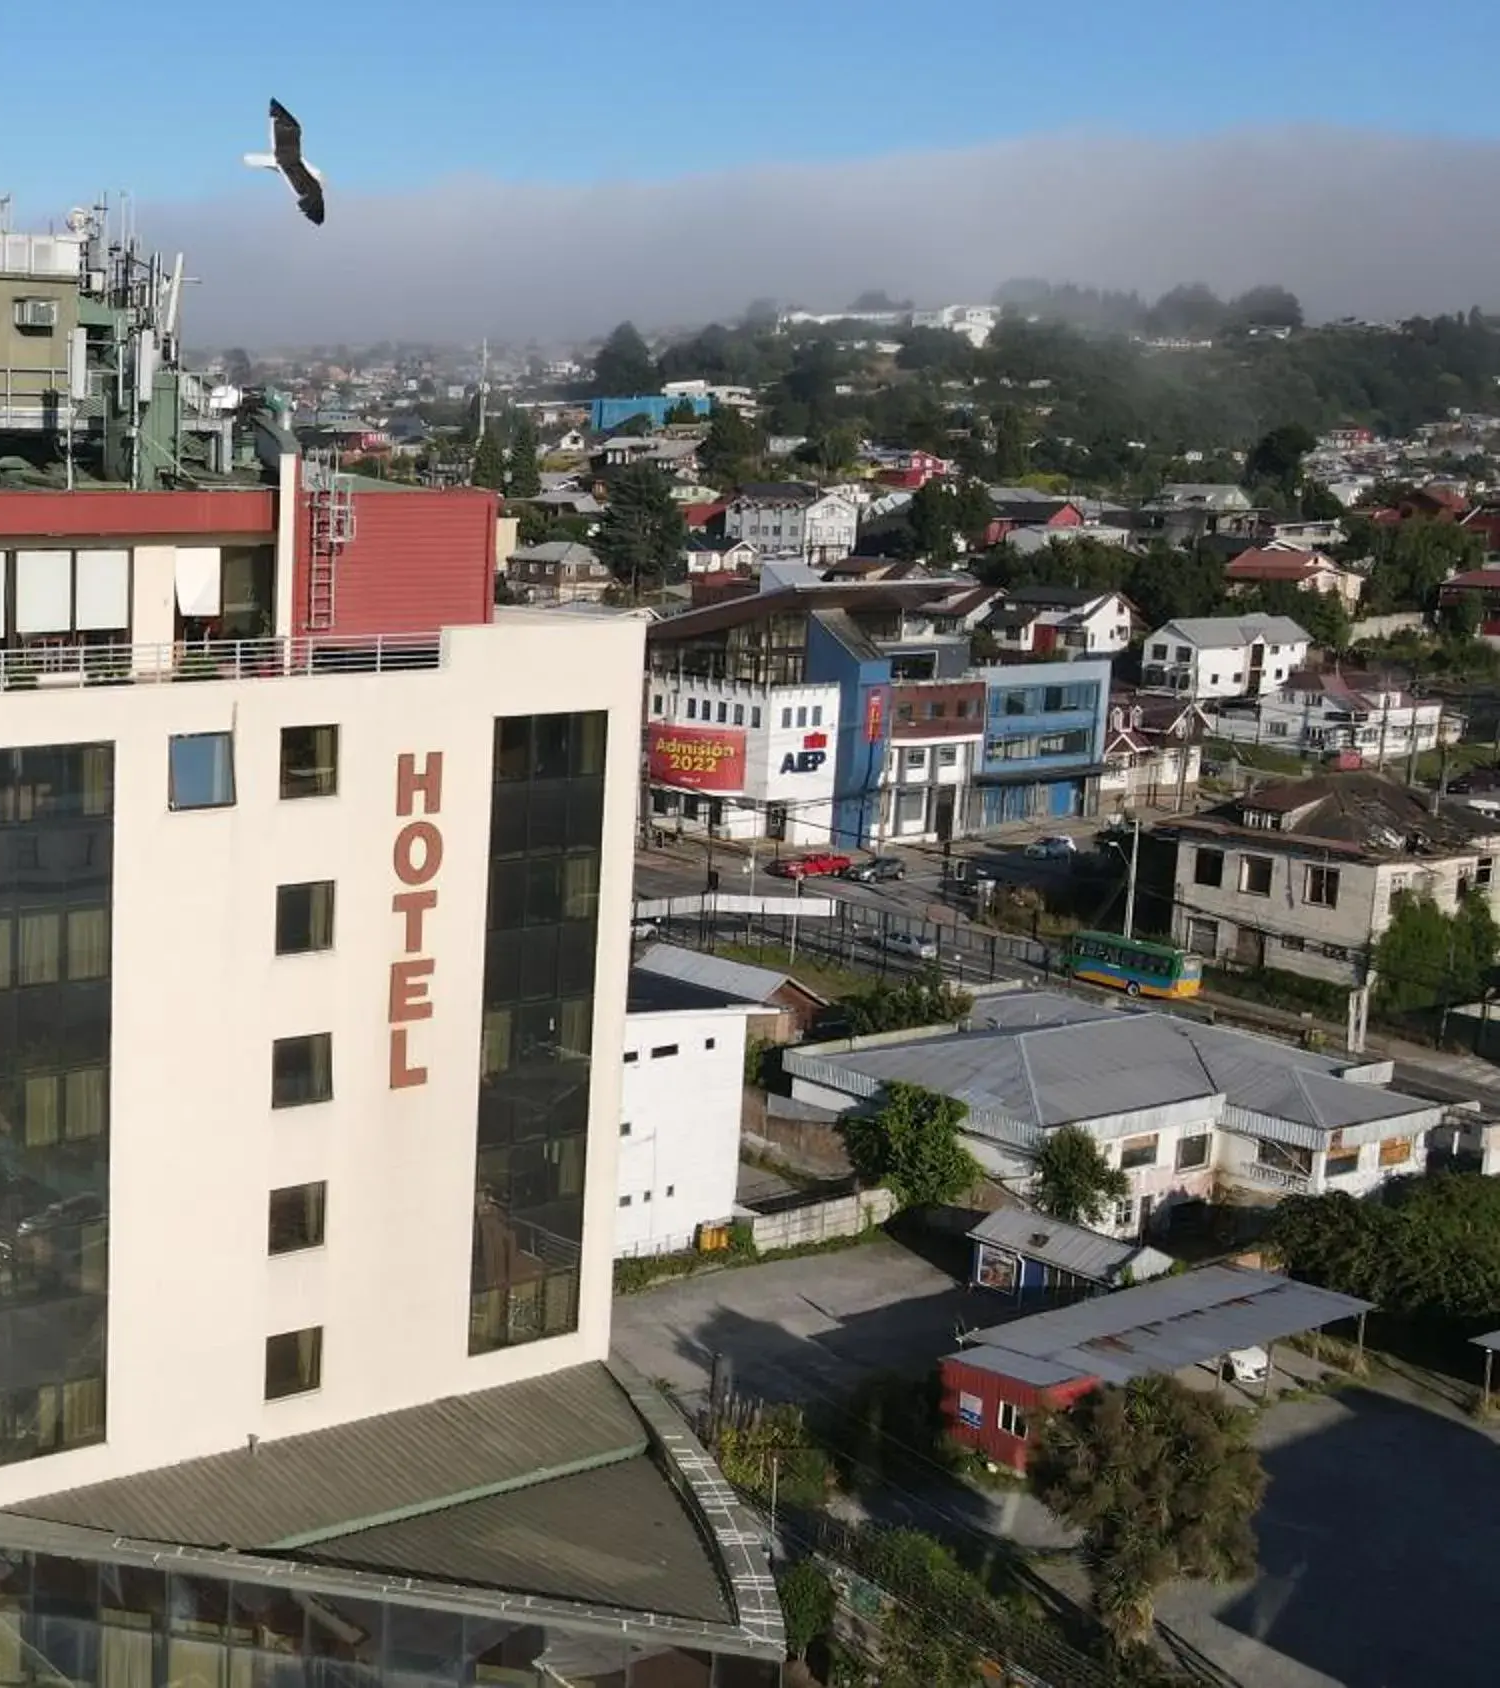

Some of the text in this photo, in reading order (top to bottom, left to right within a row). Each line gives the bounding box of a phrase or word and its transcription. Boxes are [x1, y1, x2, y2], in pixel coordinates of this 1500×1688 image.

[656, 738, 735, 757] Admisión
[670, 754, 717, 772] 2022
[388, 751, 444, 1090] HOTEL
